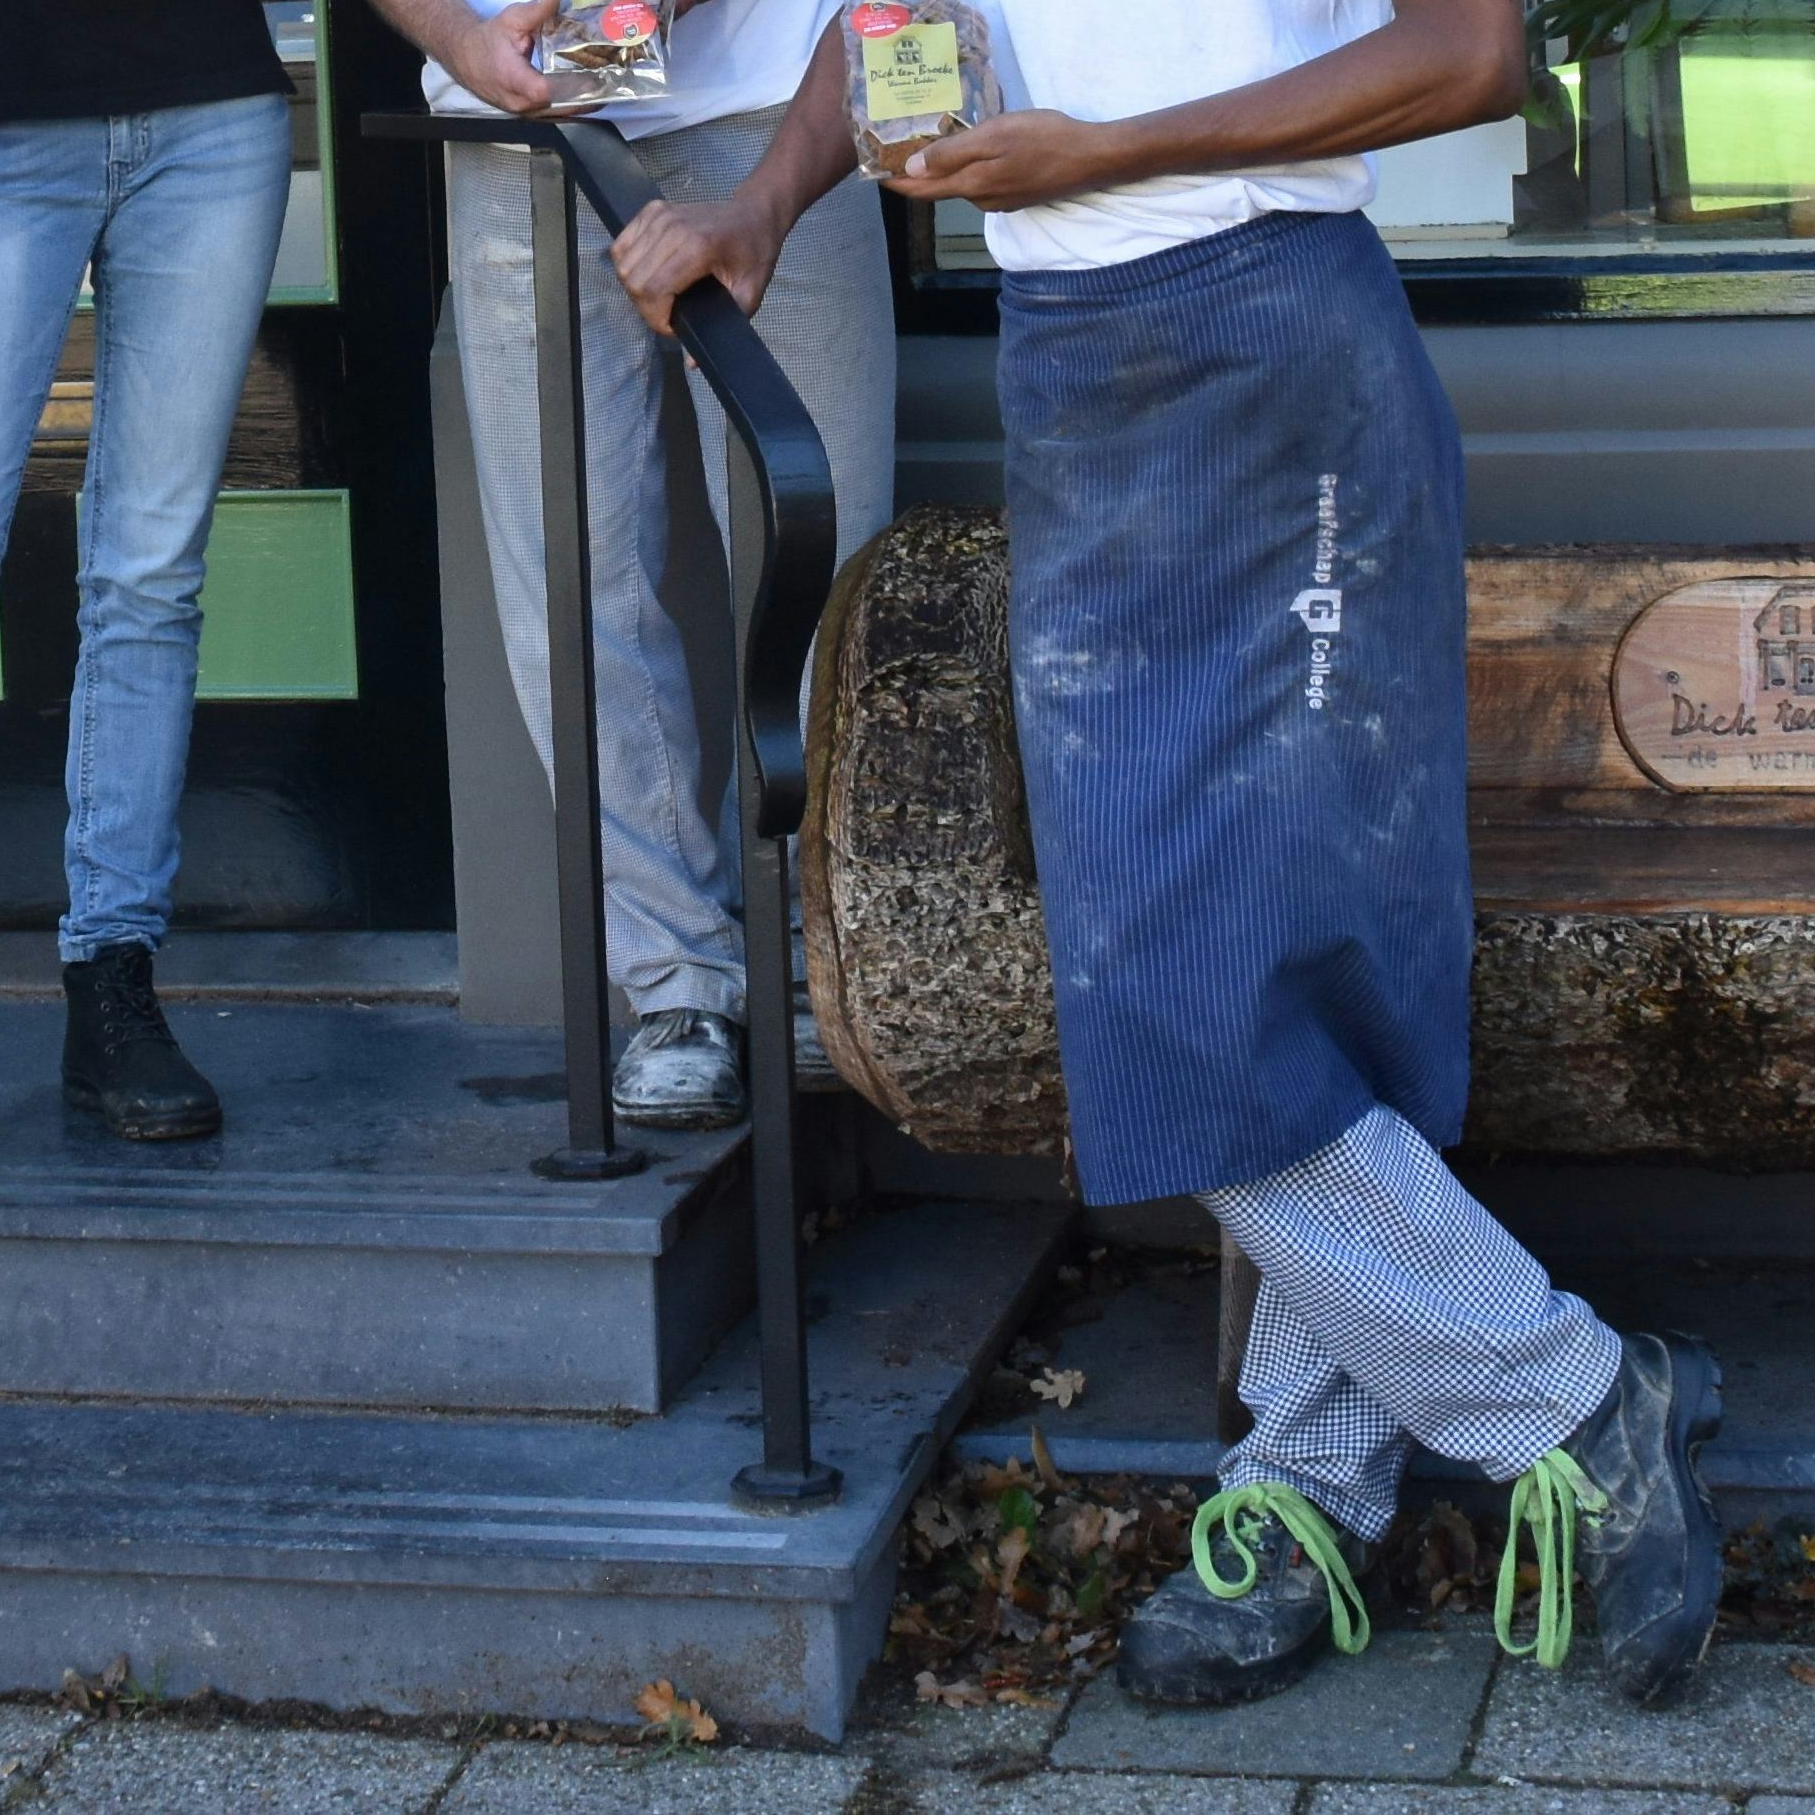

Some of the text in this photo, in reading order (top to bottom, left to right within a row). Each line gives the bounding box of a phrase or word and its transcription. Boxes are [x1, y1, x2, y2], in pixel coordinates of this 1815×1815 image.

[1311, 473, 1339, 584] Graafschap
[1305, 638, 1330, 710] College
[1671, 693, 1757, 737] Dick
[1687, 745, 1718, 770] de
